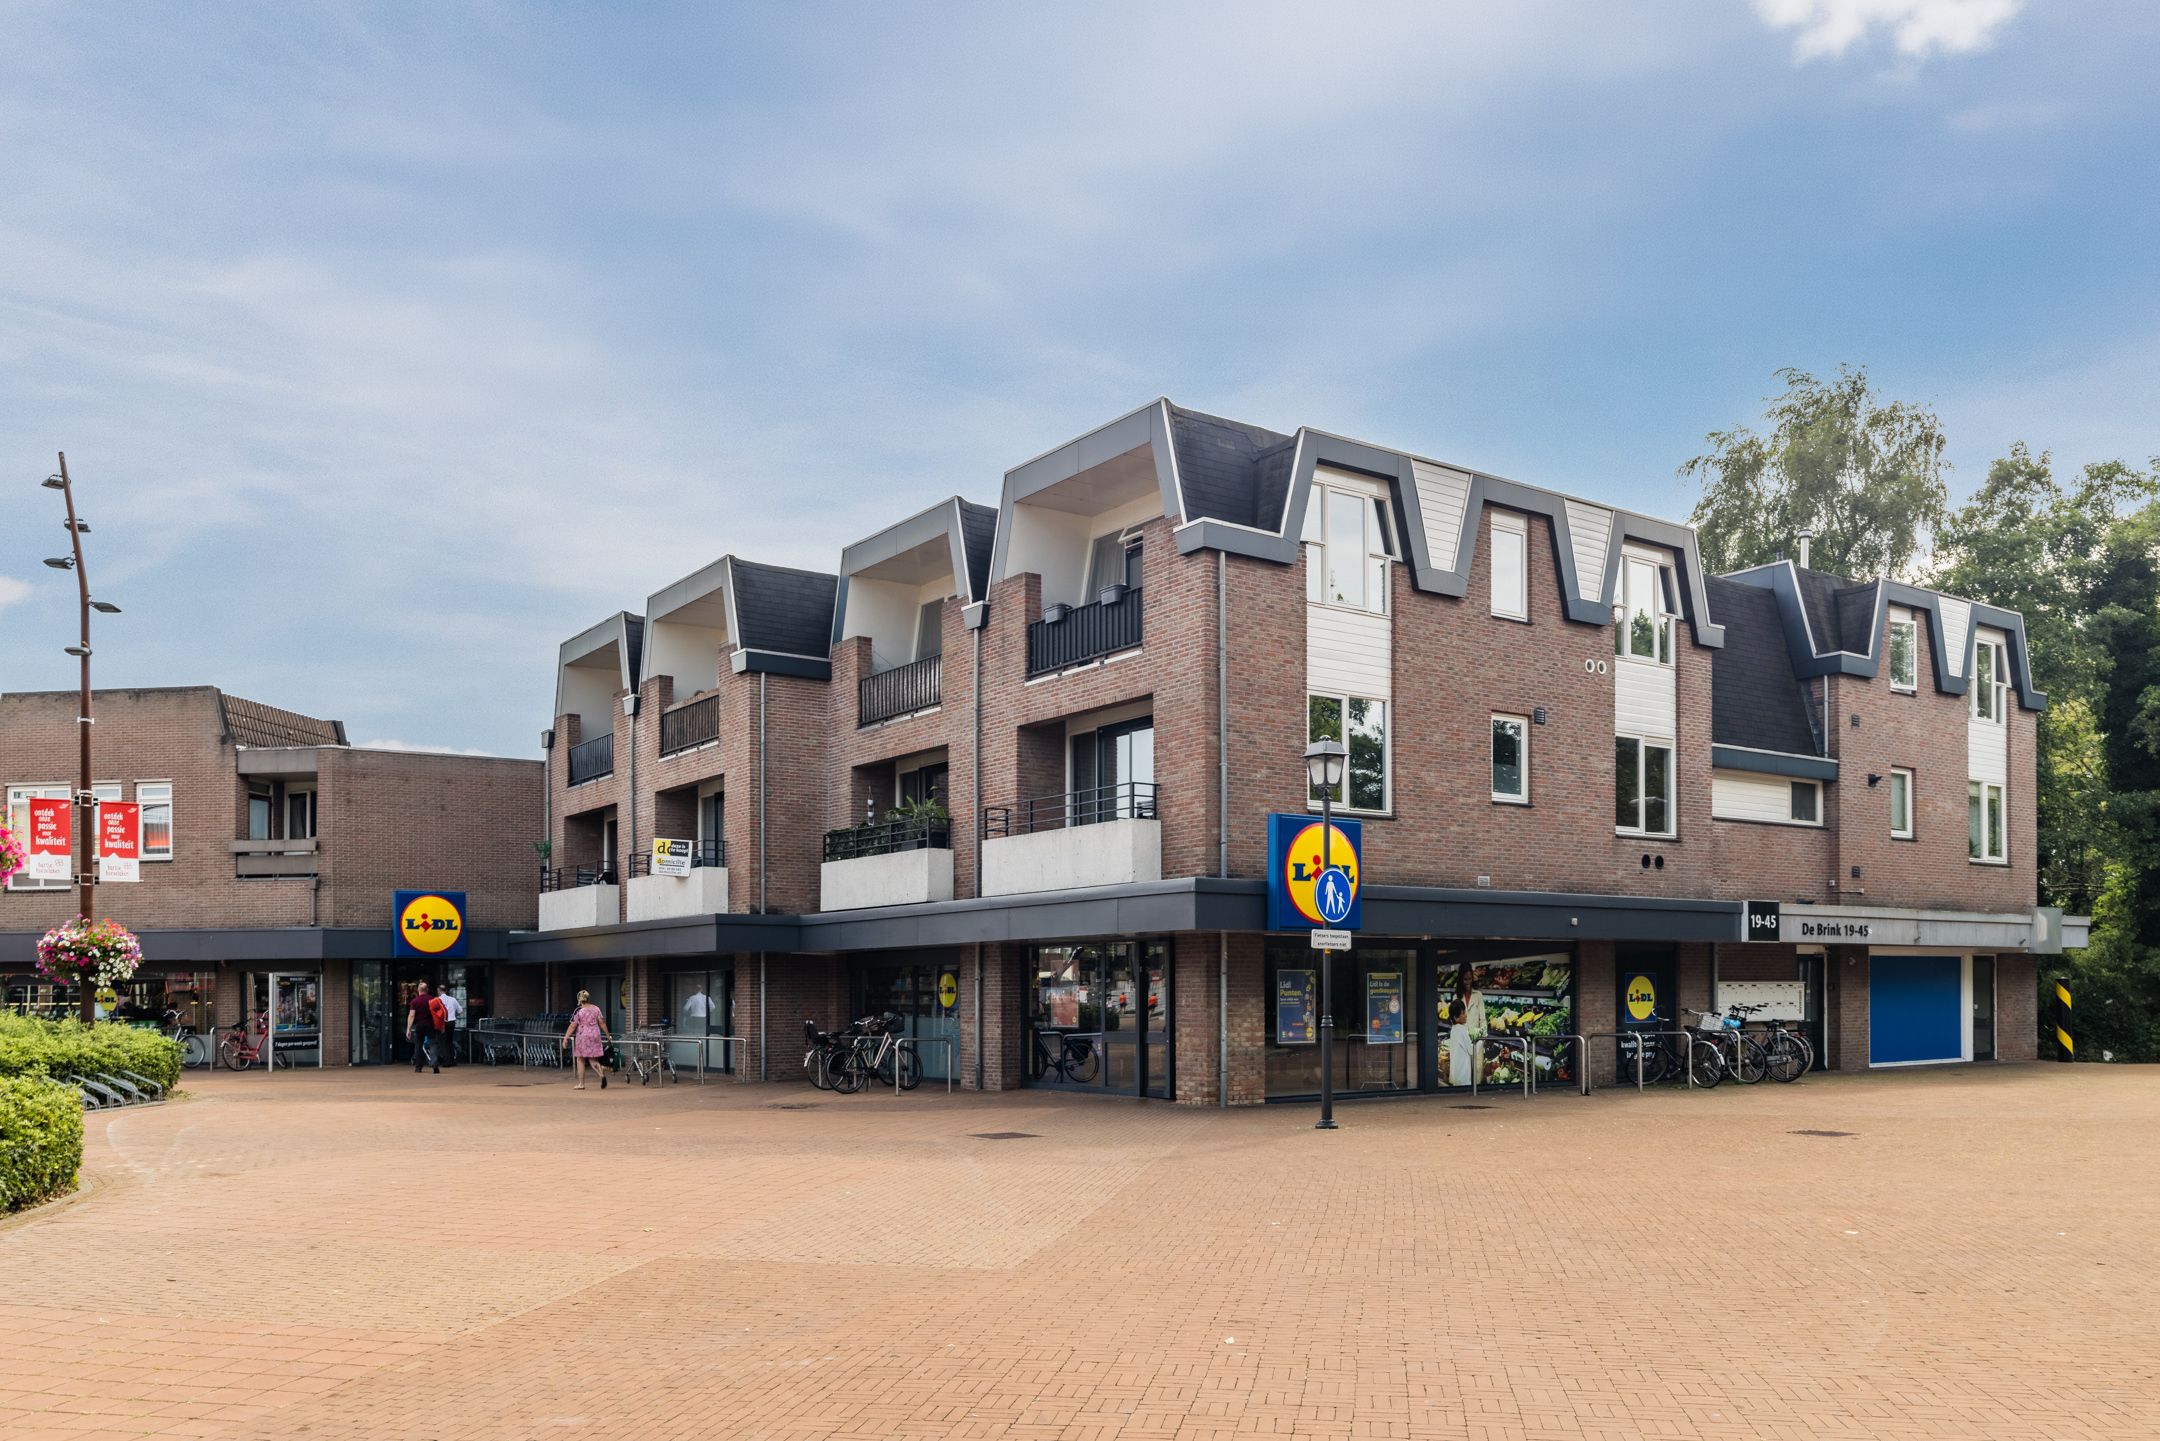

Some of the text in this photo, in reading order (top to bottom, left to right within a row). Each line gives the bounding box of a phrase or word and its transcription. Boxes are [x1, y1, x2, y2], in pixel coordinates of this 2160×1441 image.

[33, 808, 54, 817] ontdek
[104, 812, 123, 820] ontdek
[37, 821, 56, 831] passie
[107, 825, 125, 834] passie
[35, 836, 66, 846] kwaliteit
[105, 839, 134, 849] kwaliteit
[1750, 914, 1777, 929] 19-45
[1801, 922, 1870, 937] De Brink 19-45
